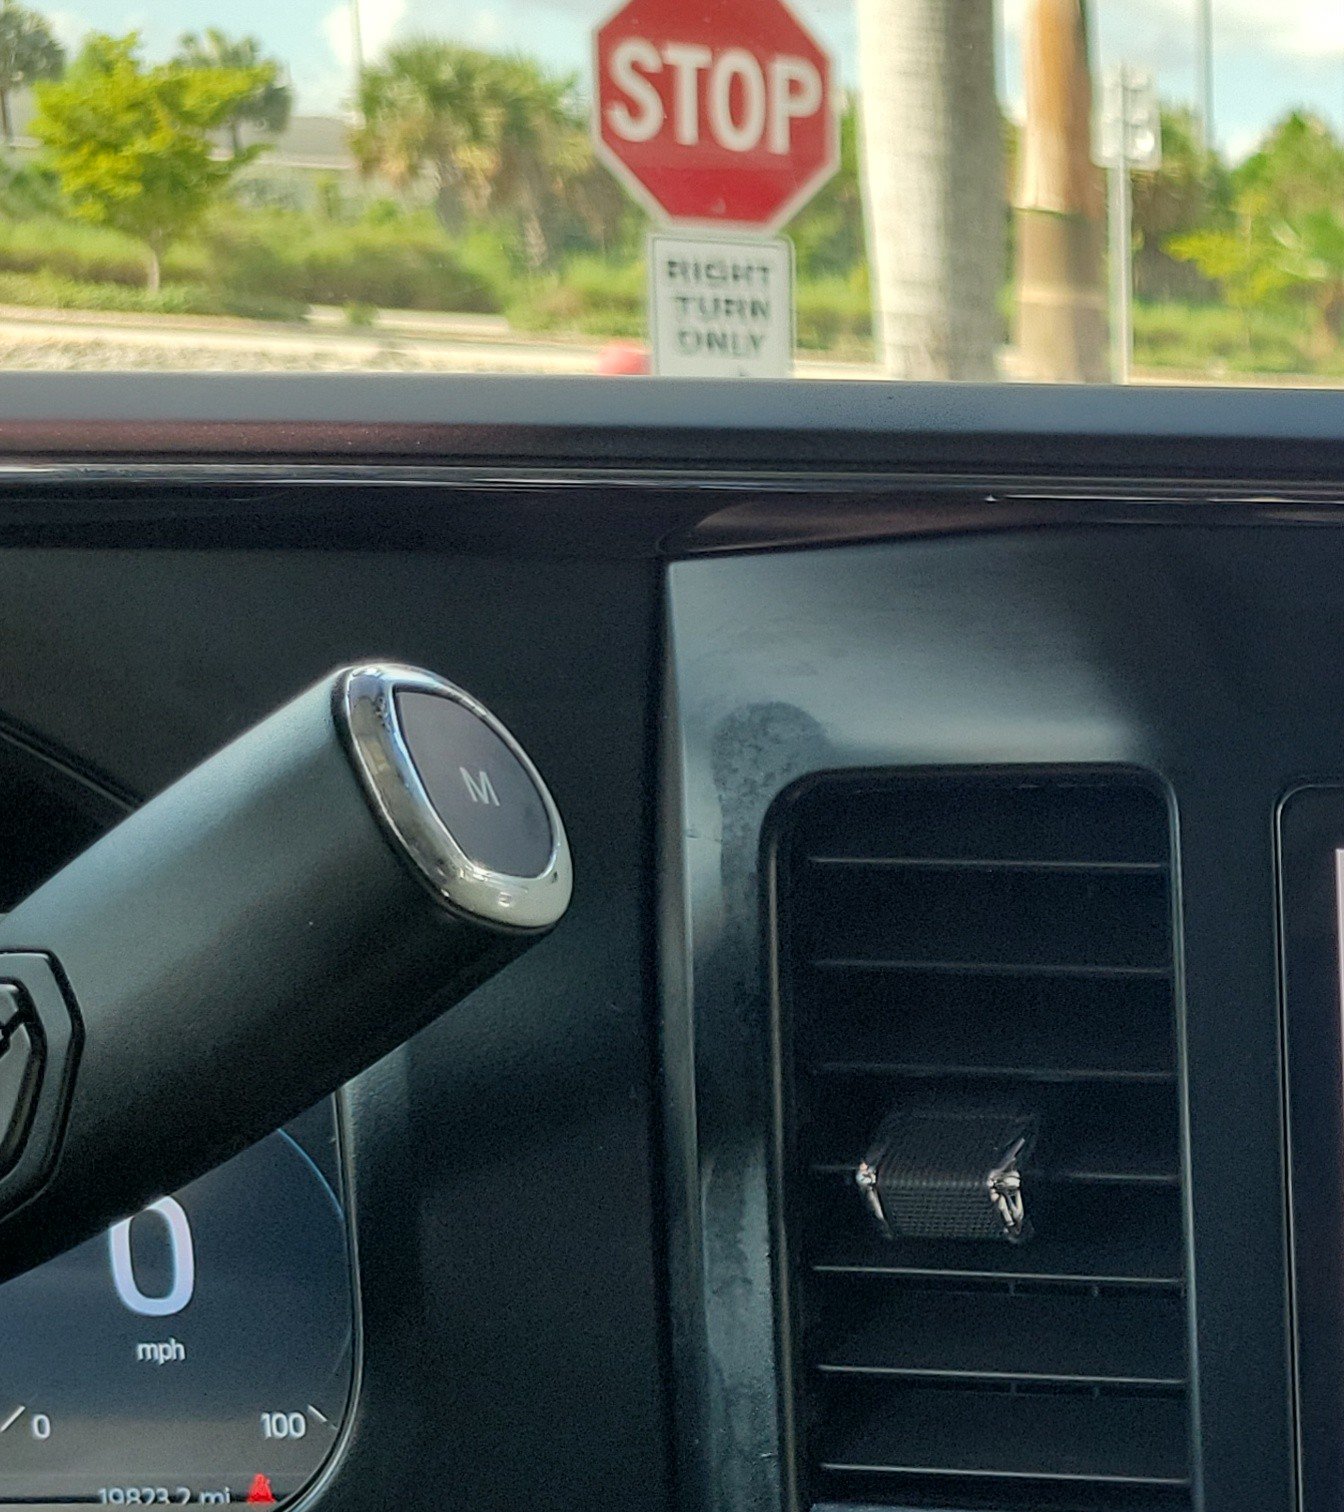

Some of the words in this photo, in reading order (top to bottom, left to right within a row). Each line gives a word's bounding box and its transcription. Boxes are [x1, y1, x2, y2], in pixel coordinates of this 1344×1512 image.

[605, 37, 823, 155] STOP
[668, 260, 769, 283] RIGHT
[674, 295, 770, 320] TURN
[678, 329, 765, 356] ONLY
[460, 766, 500, 807] M
[109, 1196, 195, 1317] 0
[137, 1338, 186, 1365] mph
[32, 1415, 51, 1439] 0
[261, 1412, 306, 1439] 100
